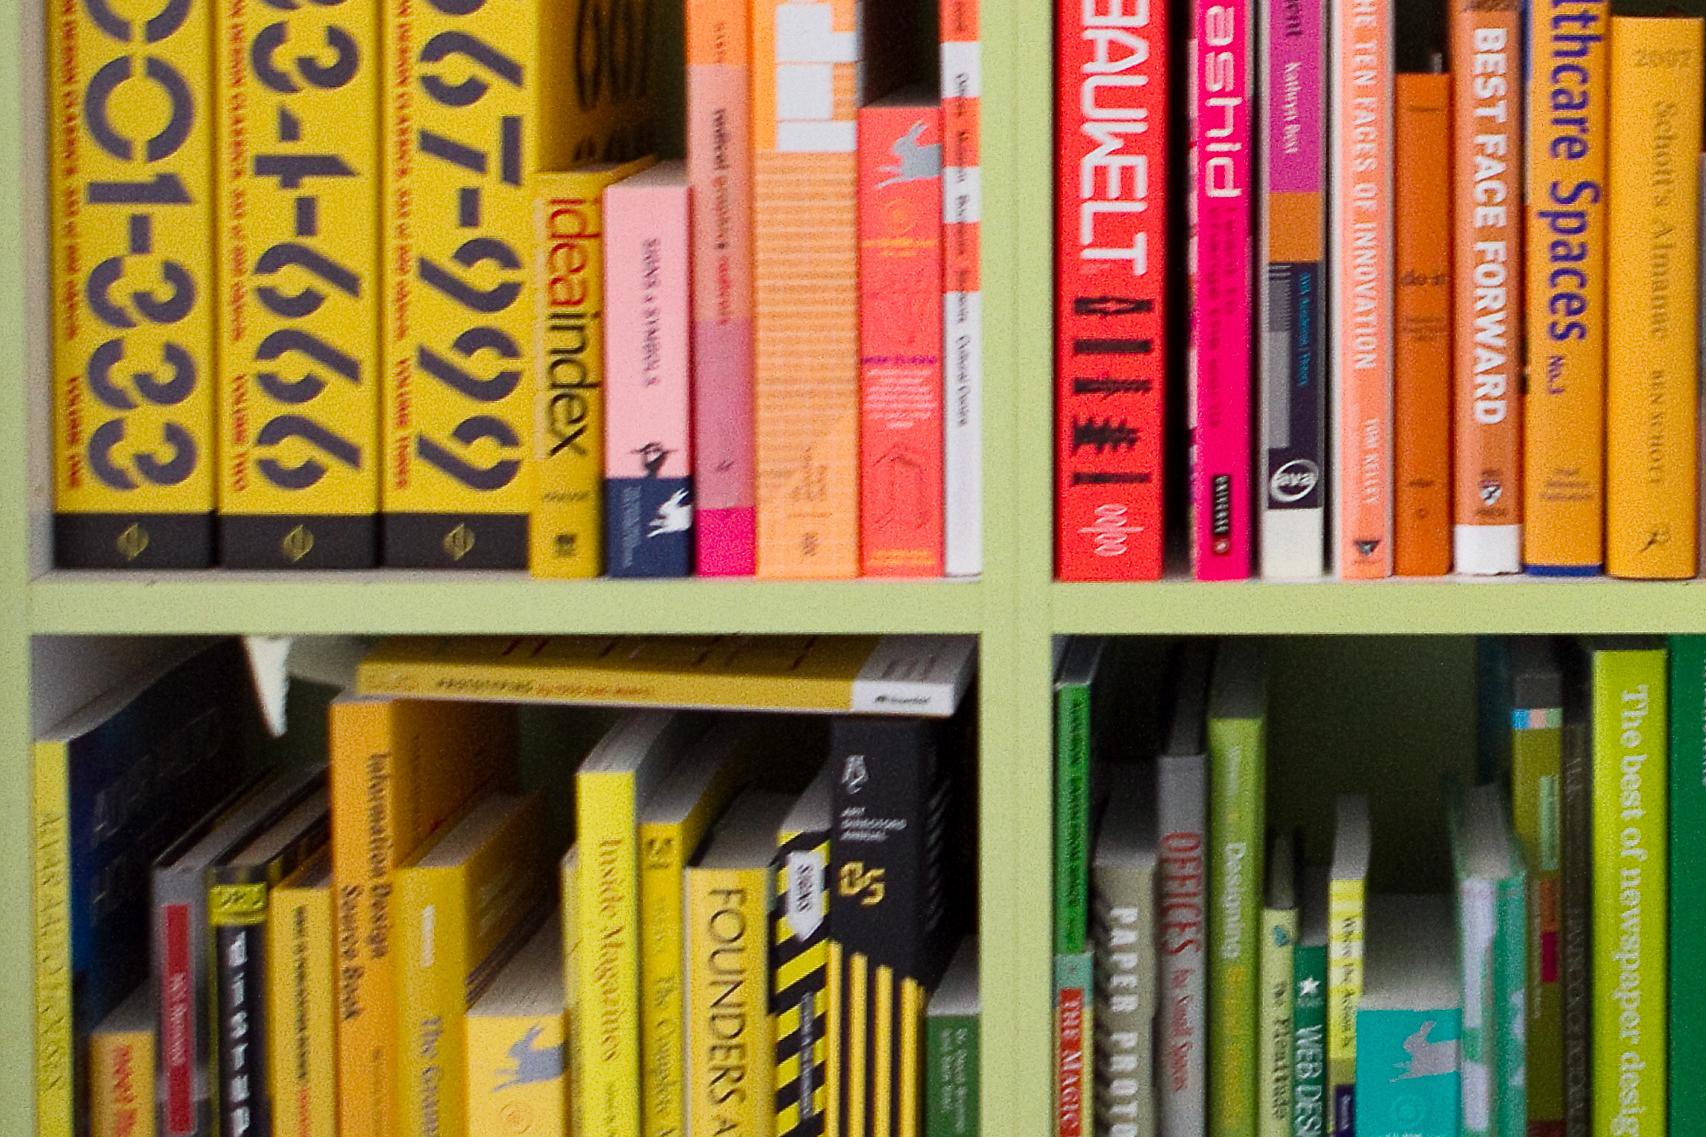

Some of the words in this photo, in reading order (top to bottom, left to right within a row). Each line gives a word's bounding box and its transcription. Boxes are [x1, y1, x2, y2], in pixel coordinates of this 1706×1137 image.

[1353, 41, 1377, 85] TEN
[1473, 27, 1506, 124] BEST
[1080, 0, 1149, 276] BAUWELT
[1353, 98, 1377, 172] FACES
[1473, 134, 1506, 227] FACE
[252, 0, 361, 490] 34-666
[417, 0, 525, 492] 67-999
[1353, 182, 1377, 213] OF
[1353, 222, 1377, 370] INNOVATION
[1537, 180, 1600, 342] Spaces
[547, 196, 601, 460] ideaindex
[1473, 241, 1506, 425] FORWARD
[1620, 685, 1648, 747] The
[1620, 754, 1647, 820] best
[796, 865, 814, 912] SIGNS
[1160, 832, 1201, 957] OFFICES
[1219, 841, 1247, 959] Designing
[1619, 827, 1647, 861] of
[707, 888, 747, 1104] FOUNDERS
[1108, 907, 1139, 1014] PAPER
[1611, 866, 1649, 1044] newspaper
[1294, 1026, 1321, 1080] WEB
